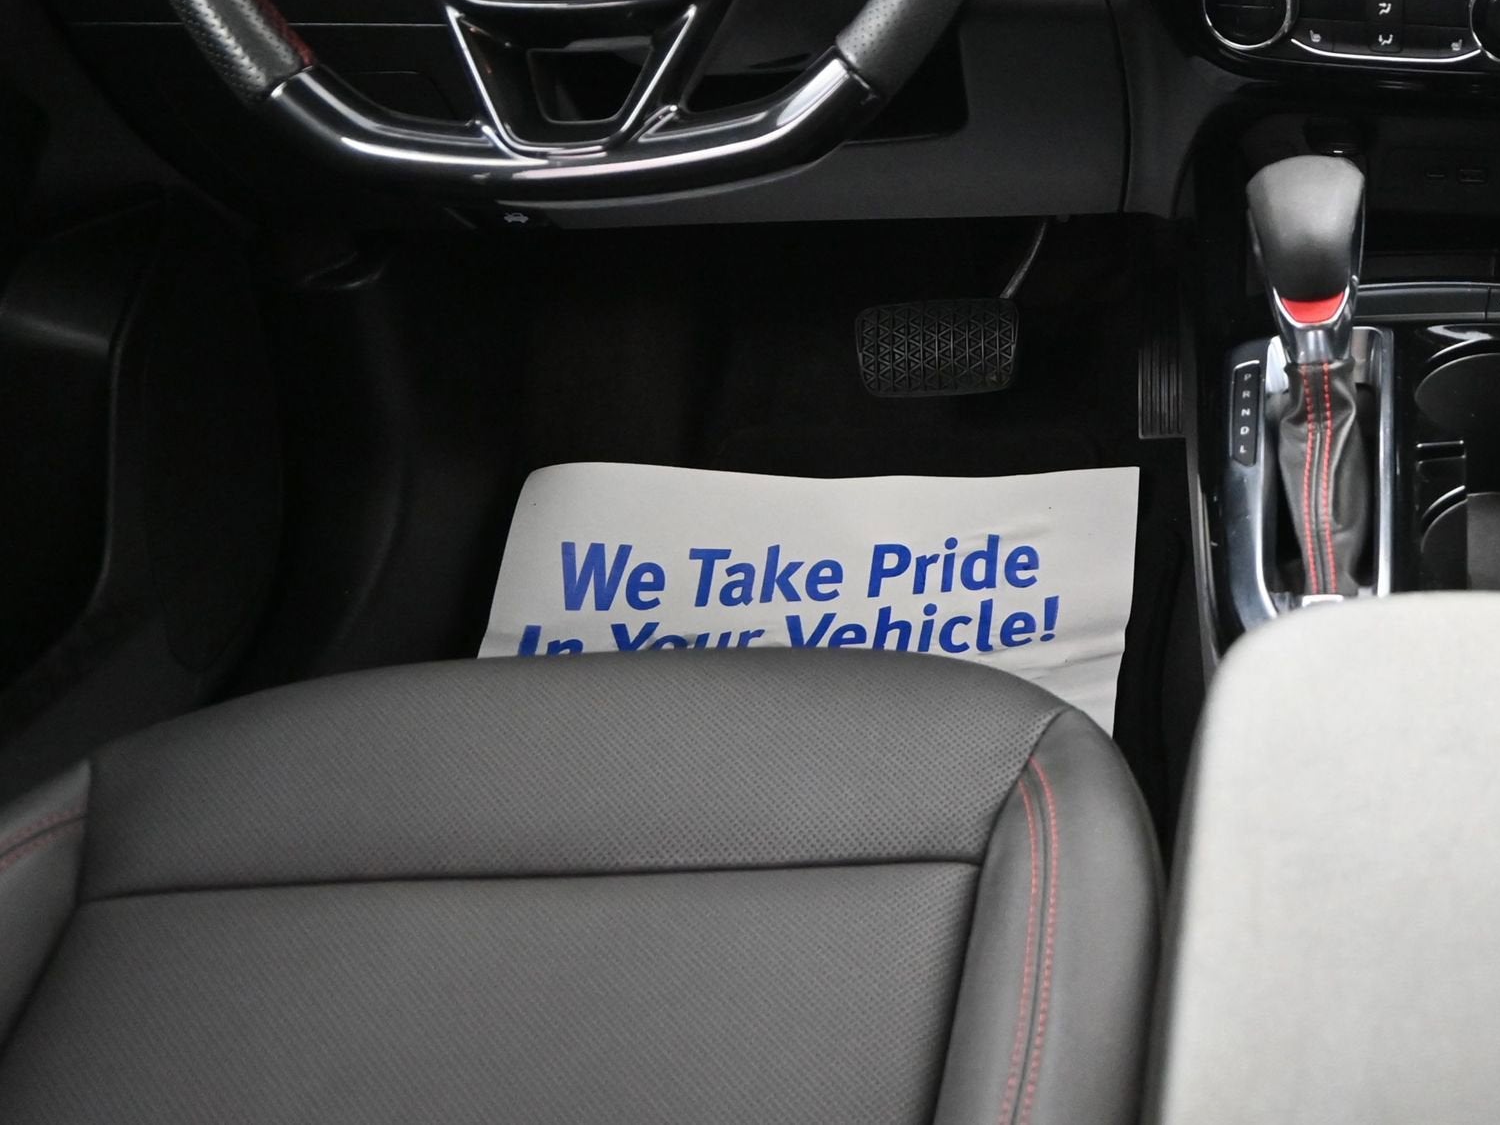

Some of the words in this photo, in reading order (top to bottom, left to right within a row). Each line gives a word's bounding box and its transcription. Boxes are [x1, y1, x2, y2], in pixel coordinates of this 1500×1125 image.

[1244, 373, 1251, 381] P
[1241, 408, 1250, 416] N
[1240, 426, 1250, 435] D
[1240, 445, 1247, 453] L
[562, 541, 667, 612] We
[689, 545, 845, 608] Take
[866, 534, 1041, 599] Pride
[785, 594, 1060, 655] Vehicle!
